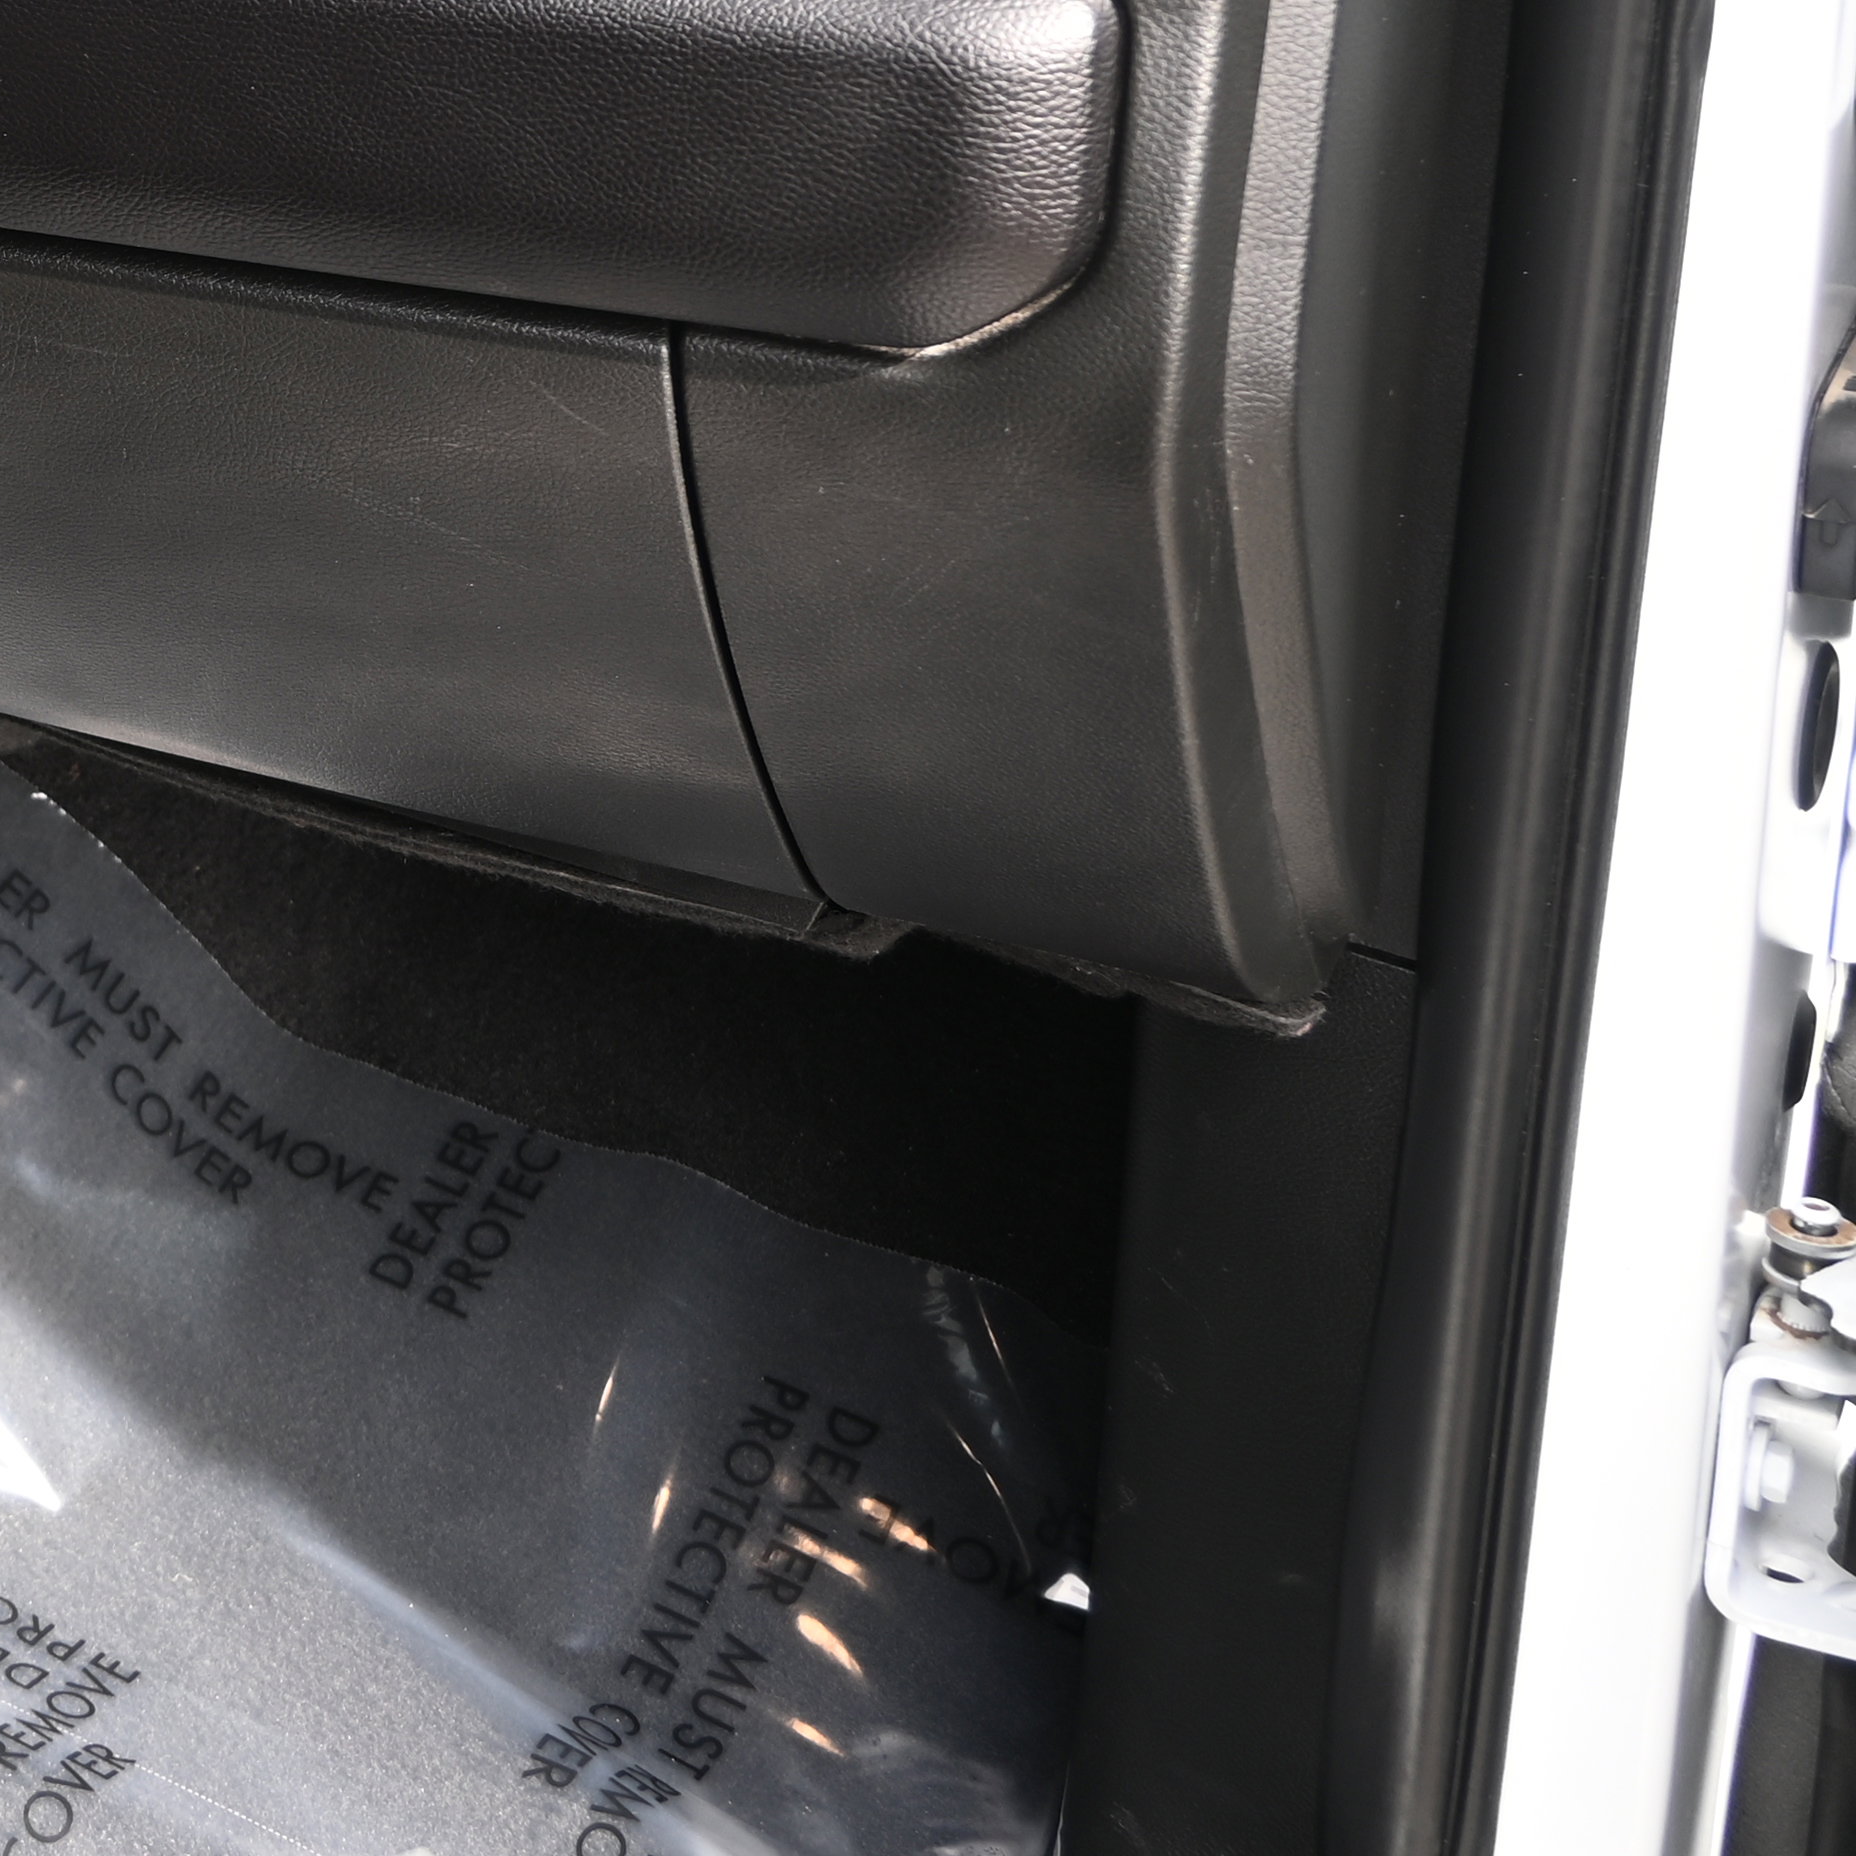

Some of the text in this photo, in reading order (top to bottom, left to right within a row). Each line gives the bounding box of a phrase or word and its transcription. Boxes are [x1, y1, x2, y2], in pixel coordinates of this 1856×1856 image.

[64, 937, 183, 1062] MUST
[188, 1070, 400, 1214] REMOVE
[110, 1063, 253, 1205] COVER
[369, 1120, 500, 1291] DEALER
[521, 1375, 810, 1788] PROTECTIVE COVER
[746, 1405, 880, 1608] DEALER
[657, 1631, 770, 1782] MUST
